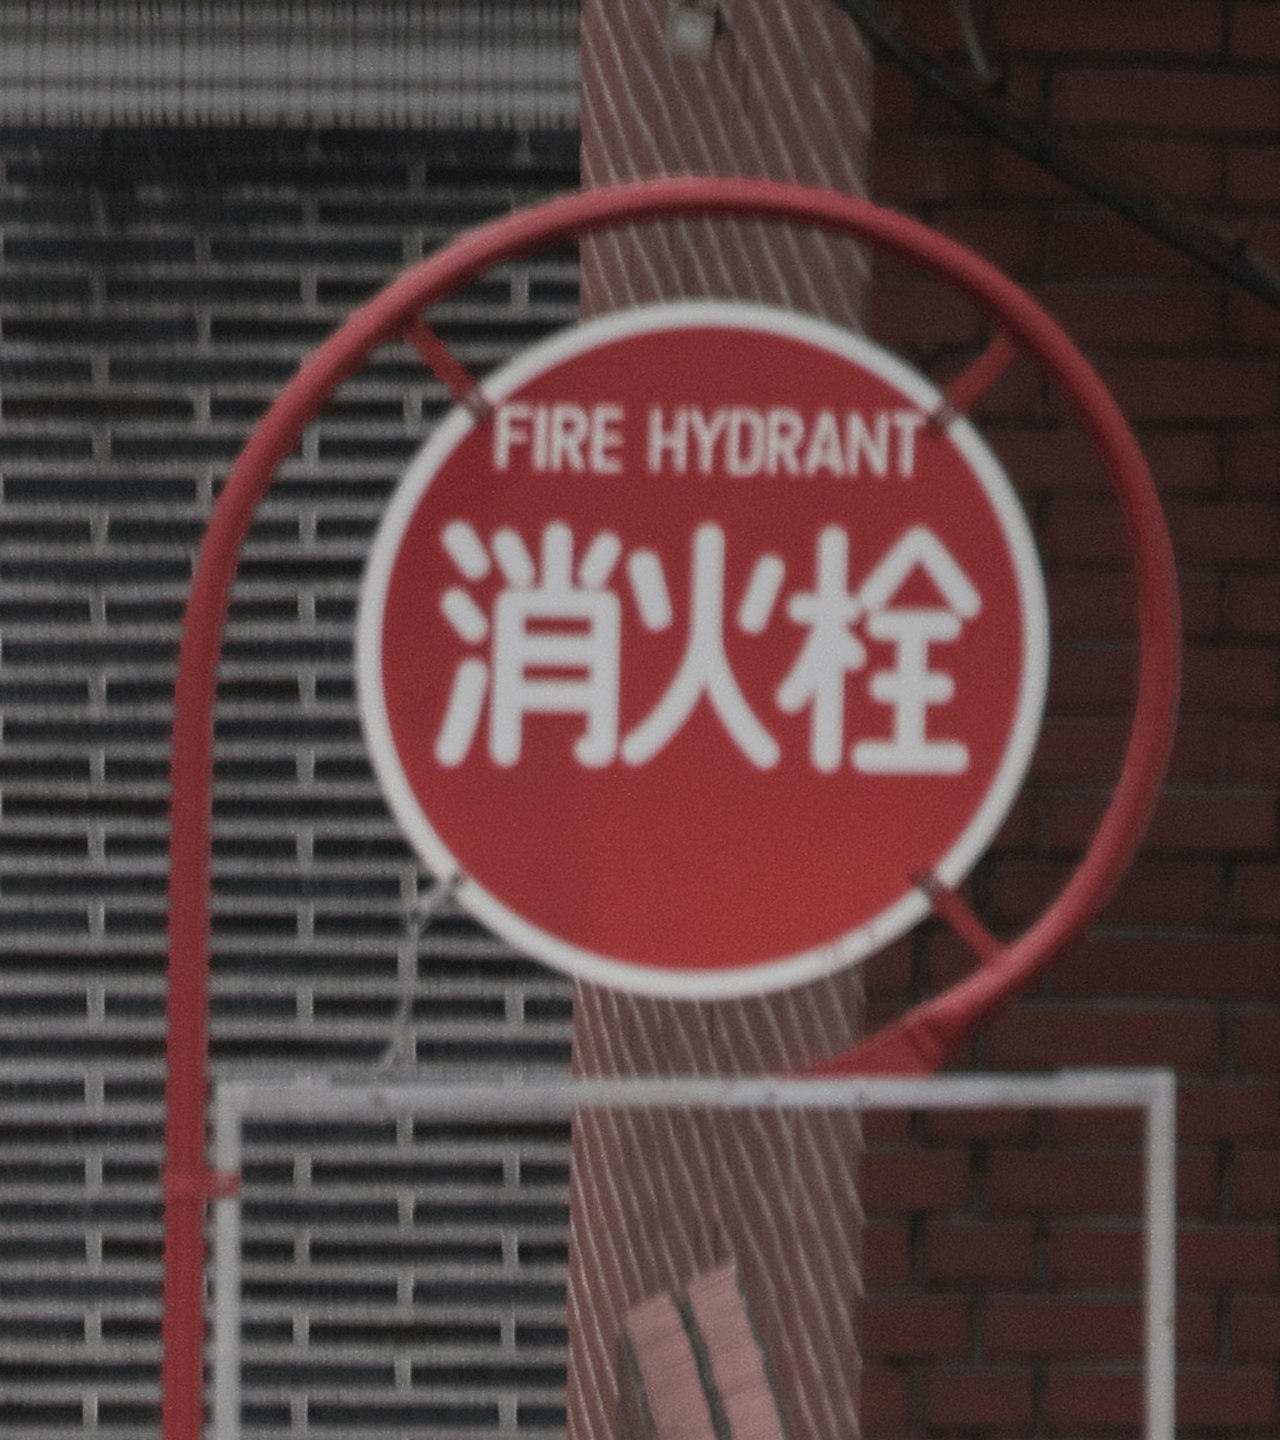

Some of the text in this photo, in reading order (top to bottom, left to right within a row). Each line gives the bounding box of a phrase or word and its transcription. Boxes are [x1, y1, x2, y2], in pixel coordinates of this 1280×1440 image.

[493, 403, 925, 480] FIRE HYDRANT
[435, 519, 982, 775] 消火栓
